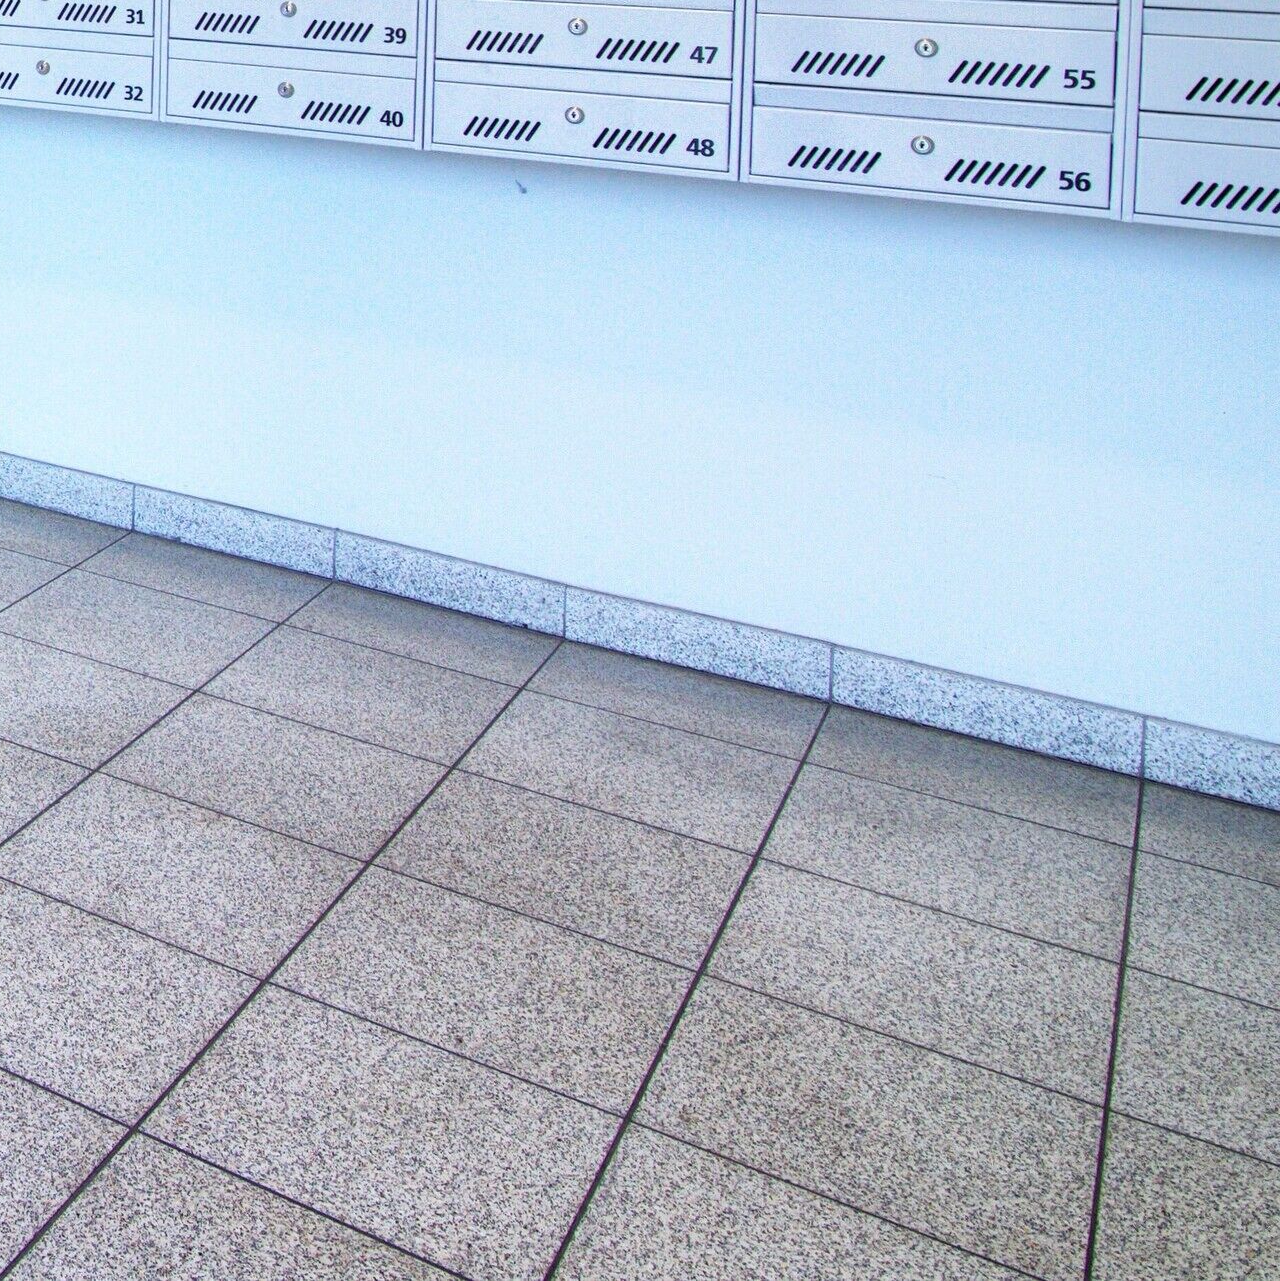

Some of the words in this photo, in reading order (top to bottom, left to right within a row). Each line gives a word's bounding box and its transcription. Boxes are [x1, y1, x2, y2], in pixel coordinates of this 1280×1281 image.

[125, 8, 145, 25] 31
[383, 26, 407, 45] 39
[689, 45, 719, 65] 47
[1063, 68, 1096, 90] 55
[123, 85, 144, 102] 32
[379, 109, 404, 128] 40
[685, 137, 715, 158] 48
[1058, 170, 1092, 192] 56
